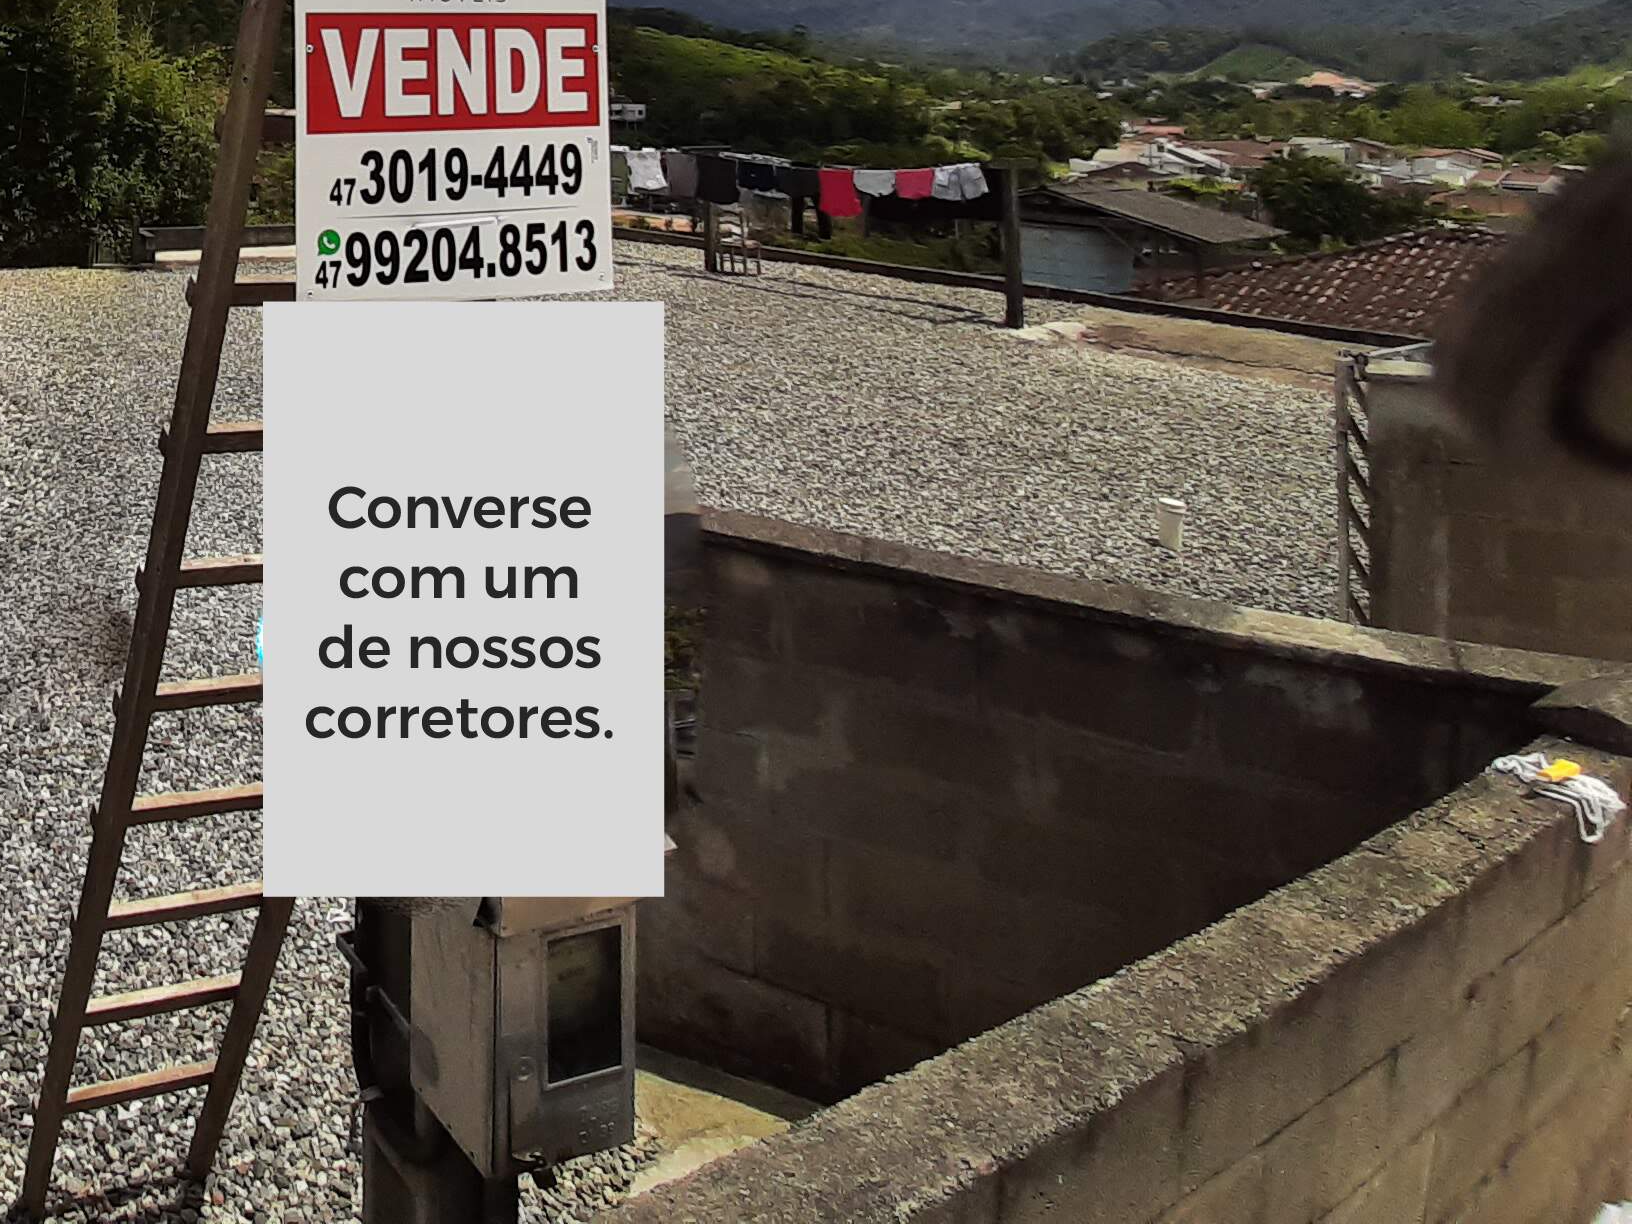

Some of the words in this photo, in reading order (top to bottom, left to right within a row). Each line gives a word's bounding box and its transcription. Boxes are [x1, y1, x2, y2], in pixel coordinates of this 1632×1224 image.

[320, 28, 588, 119] VENDE
[329, 178, 356, 206] 47
[359, 143, 583, 205] 3019-4449
[315, 260, 341, 289] 47
[344, 219, 597, 286] 99204.8513
